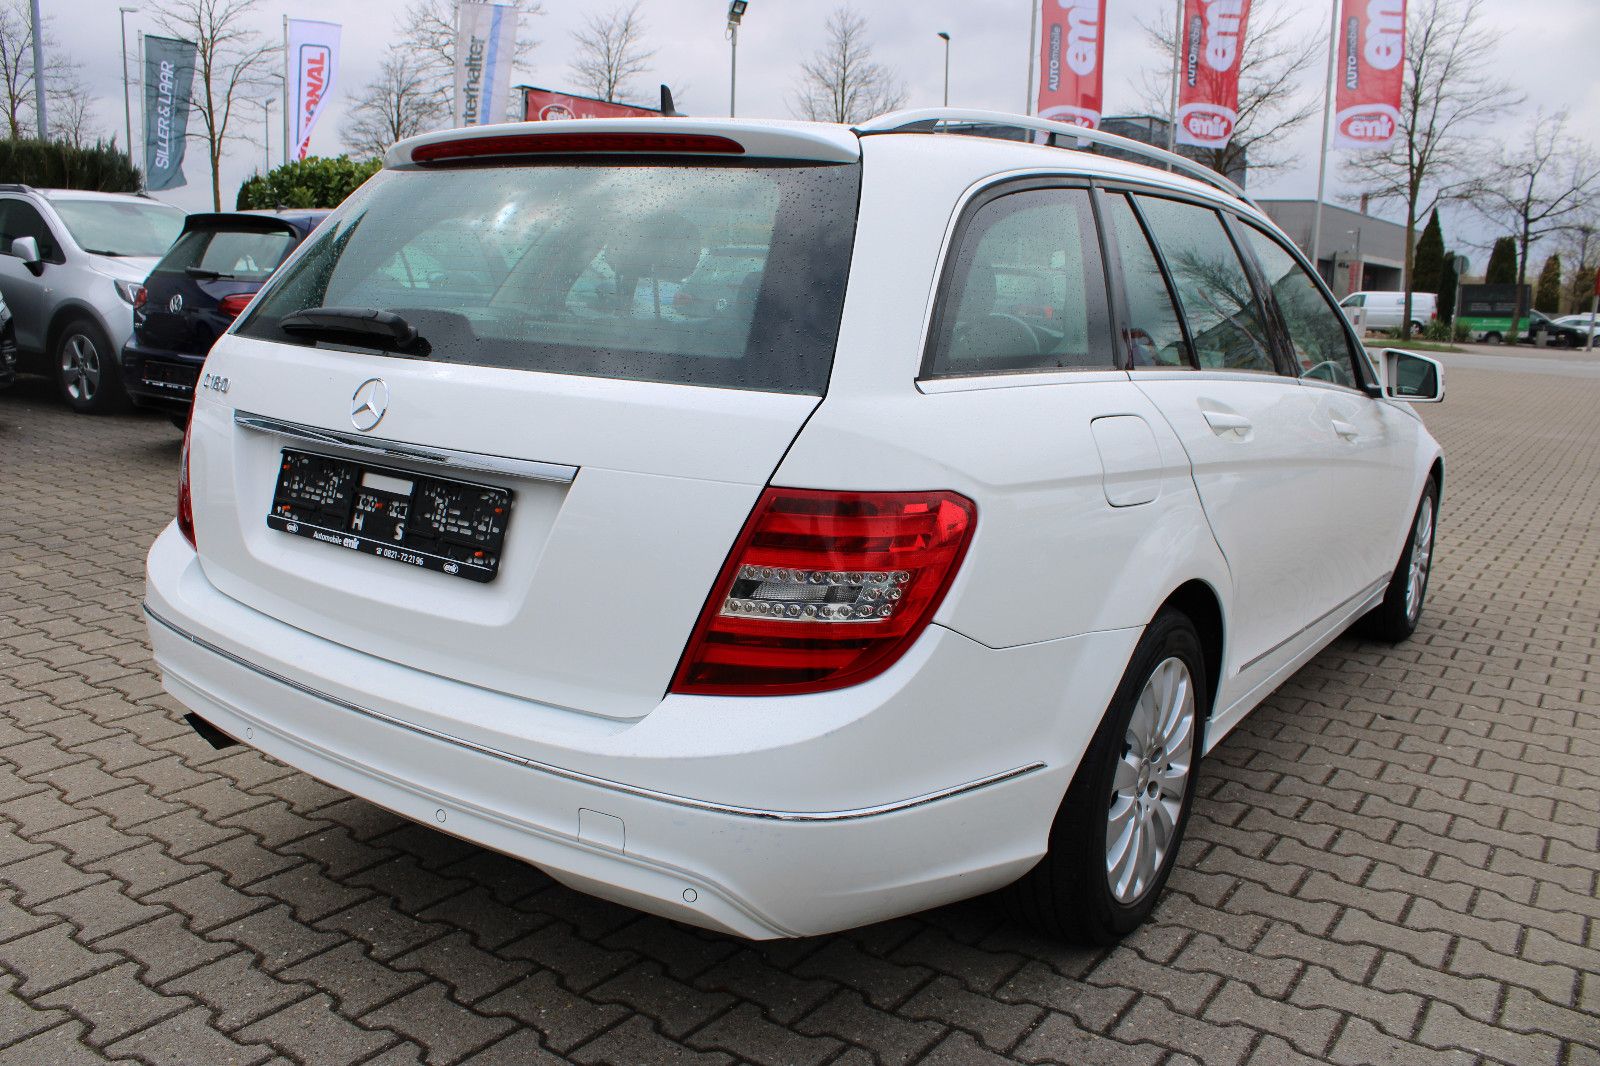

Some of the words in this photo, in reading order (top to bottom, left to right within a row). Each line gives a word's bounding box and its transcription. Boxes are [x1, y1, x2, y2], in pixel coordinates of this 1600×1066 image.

[158, 60, 175, 105] LAAR
[1188, 116, 1228, 137] emir
[1348, 115, 1392, 138] emir
[155, 119, 170, 169] SILLER
[313, 530, 342, 545] Automobile
[343, 537, 360, 550] emir
